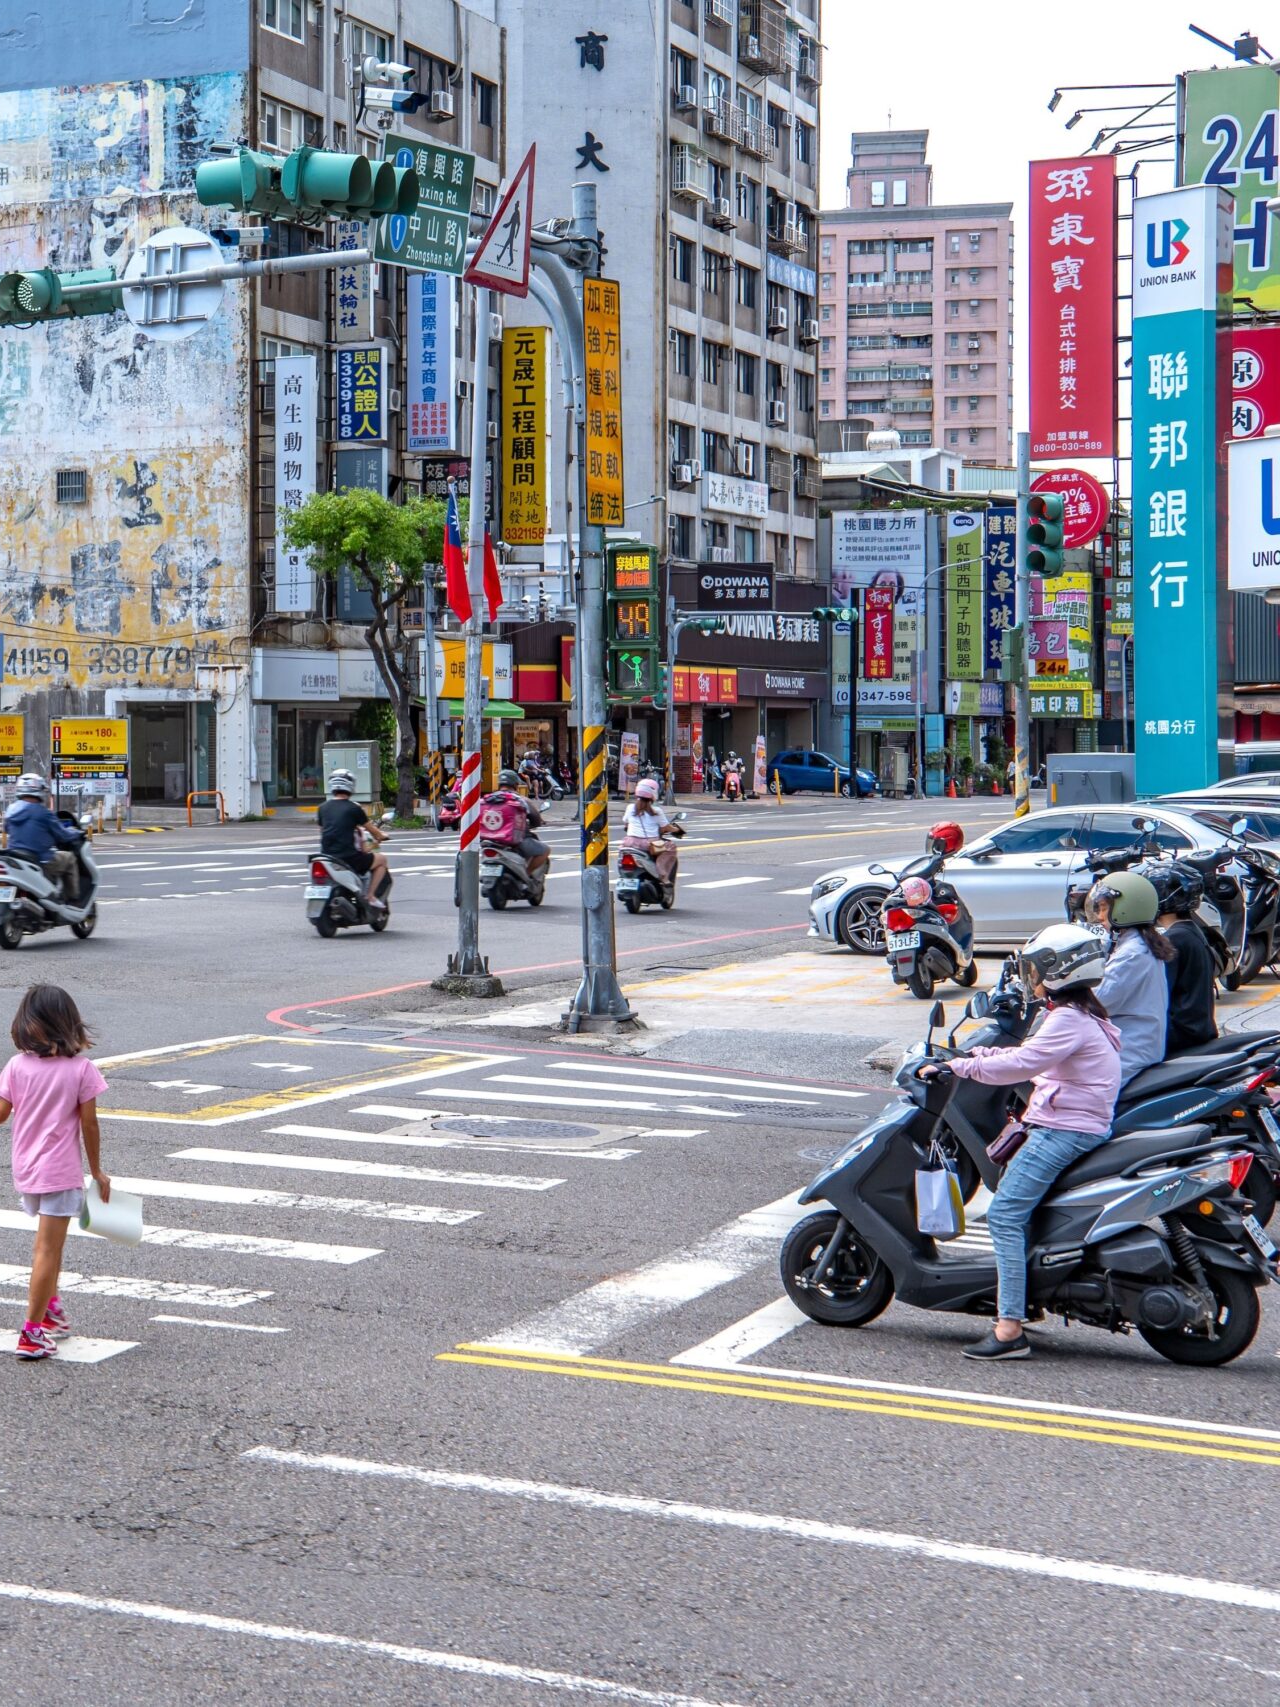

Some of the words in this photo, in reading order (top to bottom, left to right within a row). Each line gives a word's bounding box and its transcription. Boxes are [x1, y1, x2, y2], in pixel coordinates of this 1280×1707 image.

[1204, 113, 1278, 187] 24
[415, 148, 464, 186] 復興路
[419, 186, 444, 206] uxing
[446, 189, 458, 206] Rd.
[339, 221, 360, 234] 桃園
[409, 211, 458, 247] 中山路
[1044, 166, 1094, 293] 孫東寶
[405, 245, 442, 266] Zhongshan
[444, 250, 454, 268] Rd.
[1140, 273, 1169, 288] UNION
[1171, 270, 1197, 285] BANK
[421, 272, 437, 402] 園國際青年商會
[354, 351, 379, 364] 民間
[1060, 304, 1076, 410] 台式牛排教父
[340, 352, 352, 438] 3339188
[354, 365, 379, 437] 公證人
[587, 284, 603, 520] 加強違規取締
[511, 332, 536, 486] 元晟工程顧問
[603, 287, 621, 521] 前方科技執法
[1047, 431, 1089, 442] 加盟專線
[283, 375, 303, 530] 高生動物醫
[1033, 441, 1102, 453] 0800-030-889
[1148, 350, 1189, 608] 聯邦銀行
[844, 516, 917, 531] 桃園聽力所
[988, 515, 1017, 535] 建發
[505, 527, 544, 540] 3321158
[616, 556, 650, 571] 穿越馬路
[715, 576, 769, 587] DOWANA
[714, 588, 769, 599] 多瓦娜家居
[619, 603, 649, 635] 49
[777, 615, 820, 642] 多瓦娜家居
[495, 668, 508, 678] Hertz
[1037, 661, 1066, 674] 24H
[770, 676, 791, 688] DOWANA
[792, 677, 805, 689] HOME
[836, 690, 911, 702] (0)347-598
[1030, 696, 1079, 713] 誠印務
[4, 725, 14, 737] 180
[95, 728, 112, 737] 180
[1144, 719, 1196, 735] 桃園分行
[76, 742, 88, 751] 35
[889, 936, 919, 949] 513-LFS
